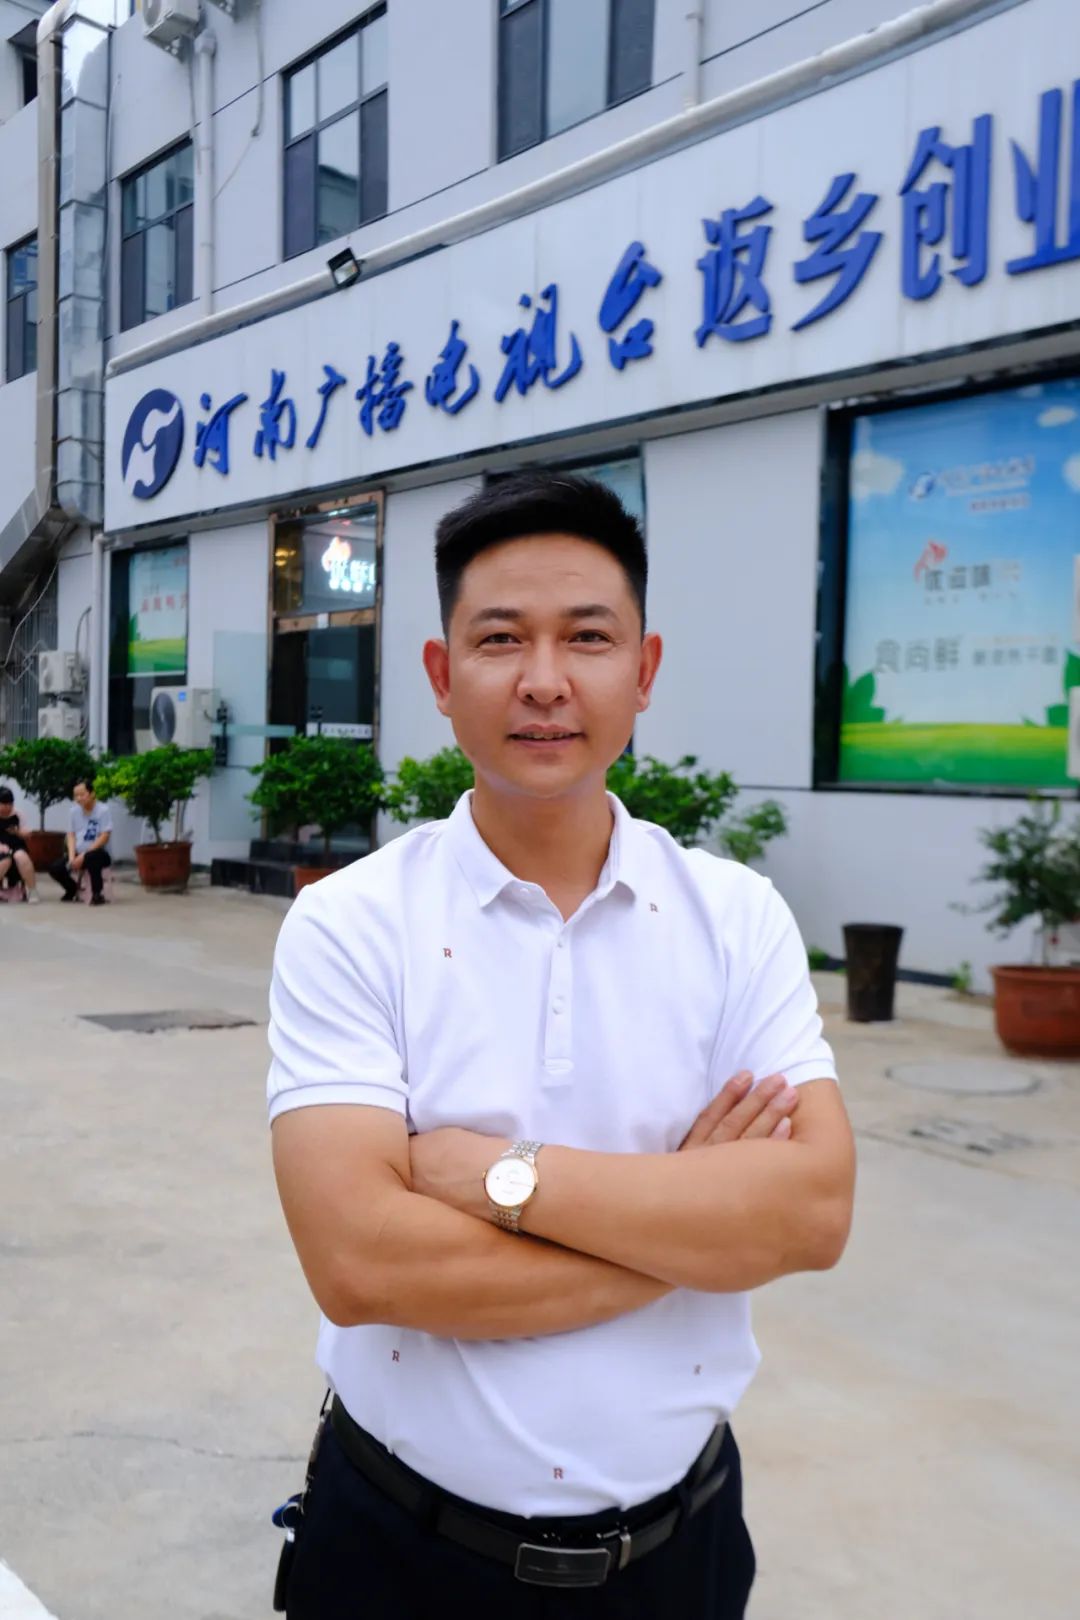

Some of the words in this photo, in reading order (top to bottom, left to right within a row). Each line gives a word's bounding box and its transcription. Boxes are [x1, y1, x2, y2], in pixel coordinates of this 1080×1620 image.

[649, 902, 659, 913] R
[442, 947, 453, 959] R
[391, 1349, 401, 1363] R
[553, 1467, 564, 1480] R
